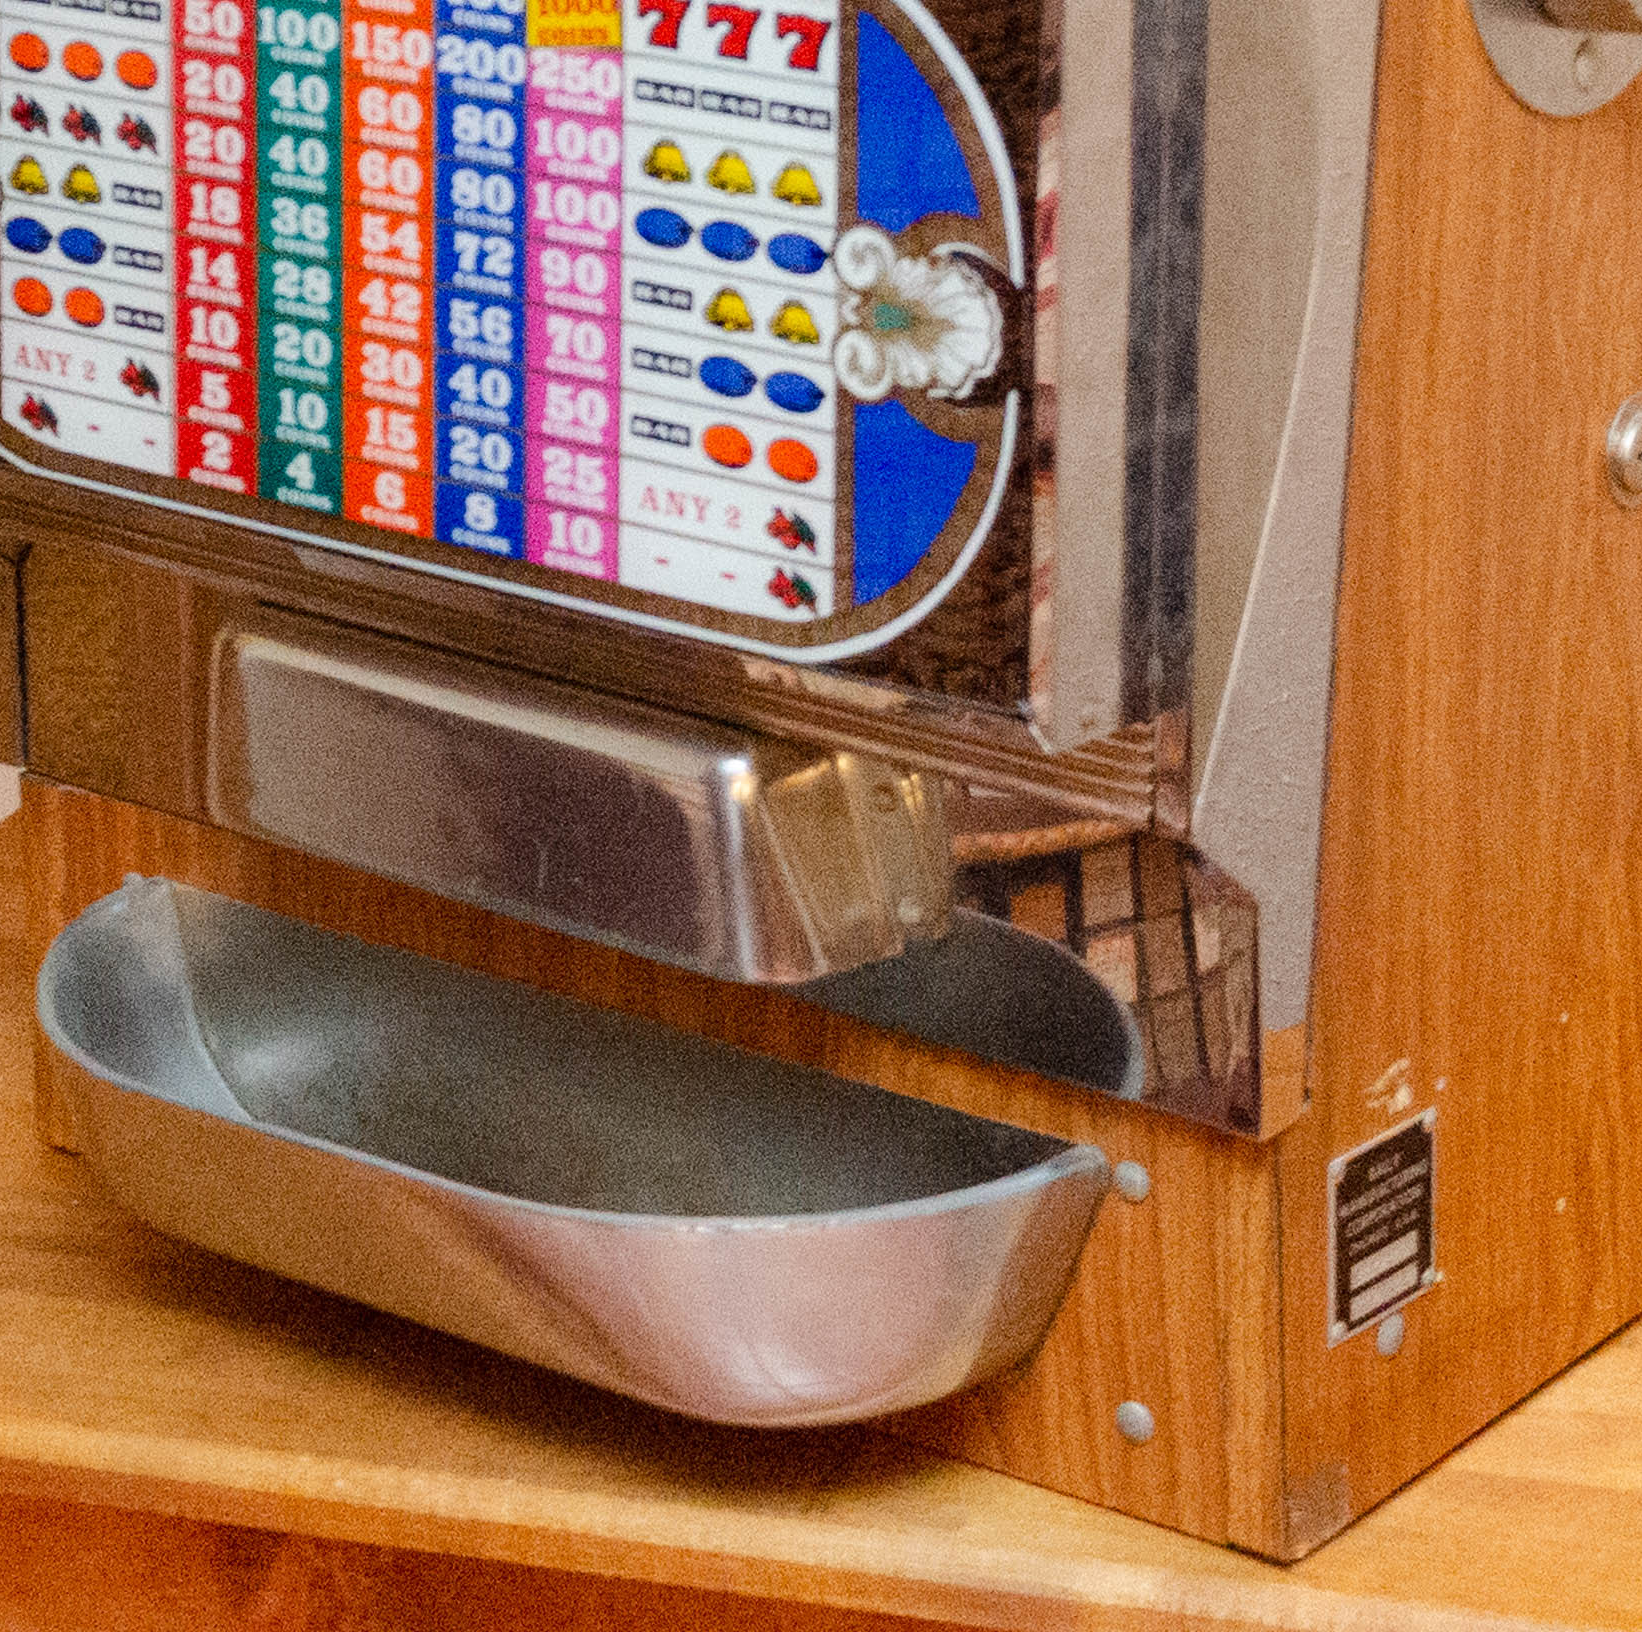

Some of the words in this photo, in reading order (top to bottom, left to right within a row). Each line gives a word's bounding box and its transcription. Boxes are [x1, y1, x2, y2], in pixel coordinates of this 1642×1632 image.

[259, 5, 340, 52] 100
[351, 20, 432, 68] 150
[436, 34, 526, 84] 200
[529, 49, 621, 99] 250
[182, 59, 245, 103] 20
[268, 71, 330, 114] 40
[358, 86, 423, 132] 60
[452, 103, 517, 149] 80
[534, 118, 621, 165] 100
[183, 119, 246, 165] 20
[268, 134, 330, 176] 40
[358, 149, 422, 195] 60
[451, 168, 515, 214] 80
[534, 182, 619, 231] 100
[271, 196, 330, 242] 36
[359, 213, 422, 260] 54
[454, 233, 514, 277] 72
[541, 248, 606, 296] 90
[189, 247, 238, 290] 14
[272, 259, 332, 305] 28
[358, 278, 422, 323] 42
[448, 299, 513, 346] 56
[545, 313, 606, 361] 70
[15, 344, 71, 378] ANY
[83, 360, 96, 382] 2
[190, 305, 239, 350] 10
[273, 322, 333, 368] 20
[360, 341, 423, 388] 30
[448, 364, 512, 408] 40
[547, 383, 609, 429] 50
[200, 370, 232, 409] 5
[277, 388, 328, 431] 10
[364, 407, 418, 451] 15
[450, 425, 512, 472] 20
[543, 446, 606, 495] 25
[201, 430, 232, 471] 2
[285, 451, 316, 491] 4
[374, 471, 406, 510] 6
[463, 492, 497, 532] 8
[548, 511, 603, 557] 10
[641, 485, 710, 522] ANY
[724, 504, 742, 529] 2
